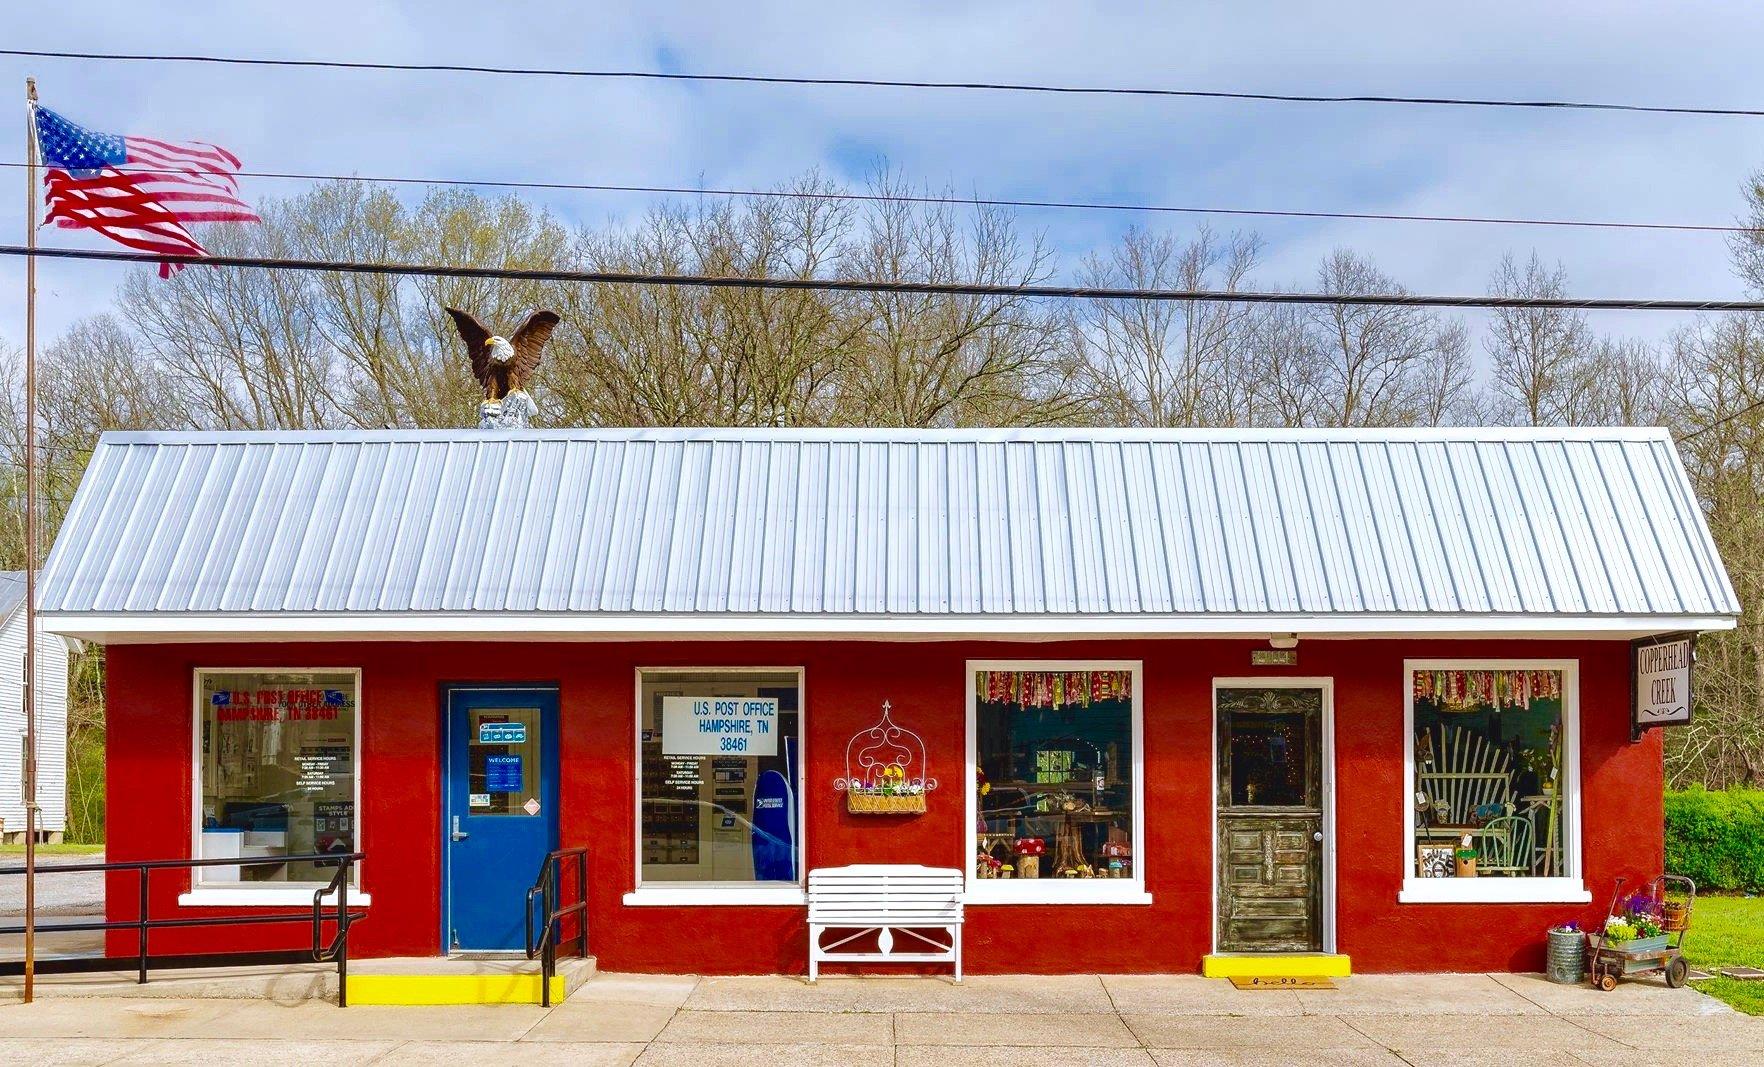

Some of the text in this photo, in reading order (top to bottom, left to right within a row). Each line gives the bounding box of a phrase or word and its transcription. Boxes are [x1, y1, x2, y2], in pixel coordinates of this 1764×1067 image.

[1639, 642, 1689, 675] COPPERHEAD
[256, 690, 283, 705] POST
[287, 690, 323, 705] OFFICE
[1651, 677, 1677, 705] CREEK
[288, 707, 301, 721] TN
[306, 707, 338, 721] 38461
[694, 702, 775, 717] U.S. POST OFFICE
[699, 720, 769, 736] HAMPSHIRE, TN
[720, 737, 747, 752] 38461
